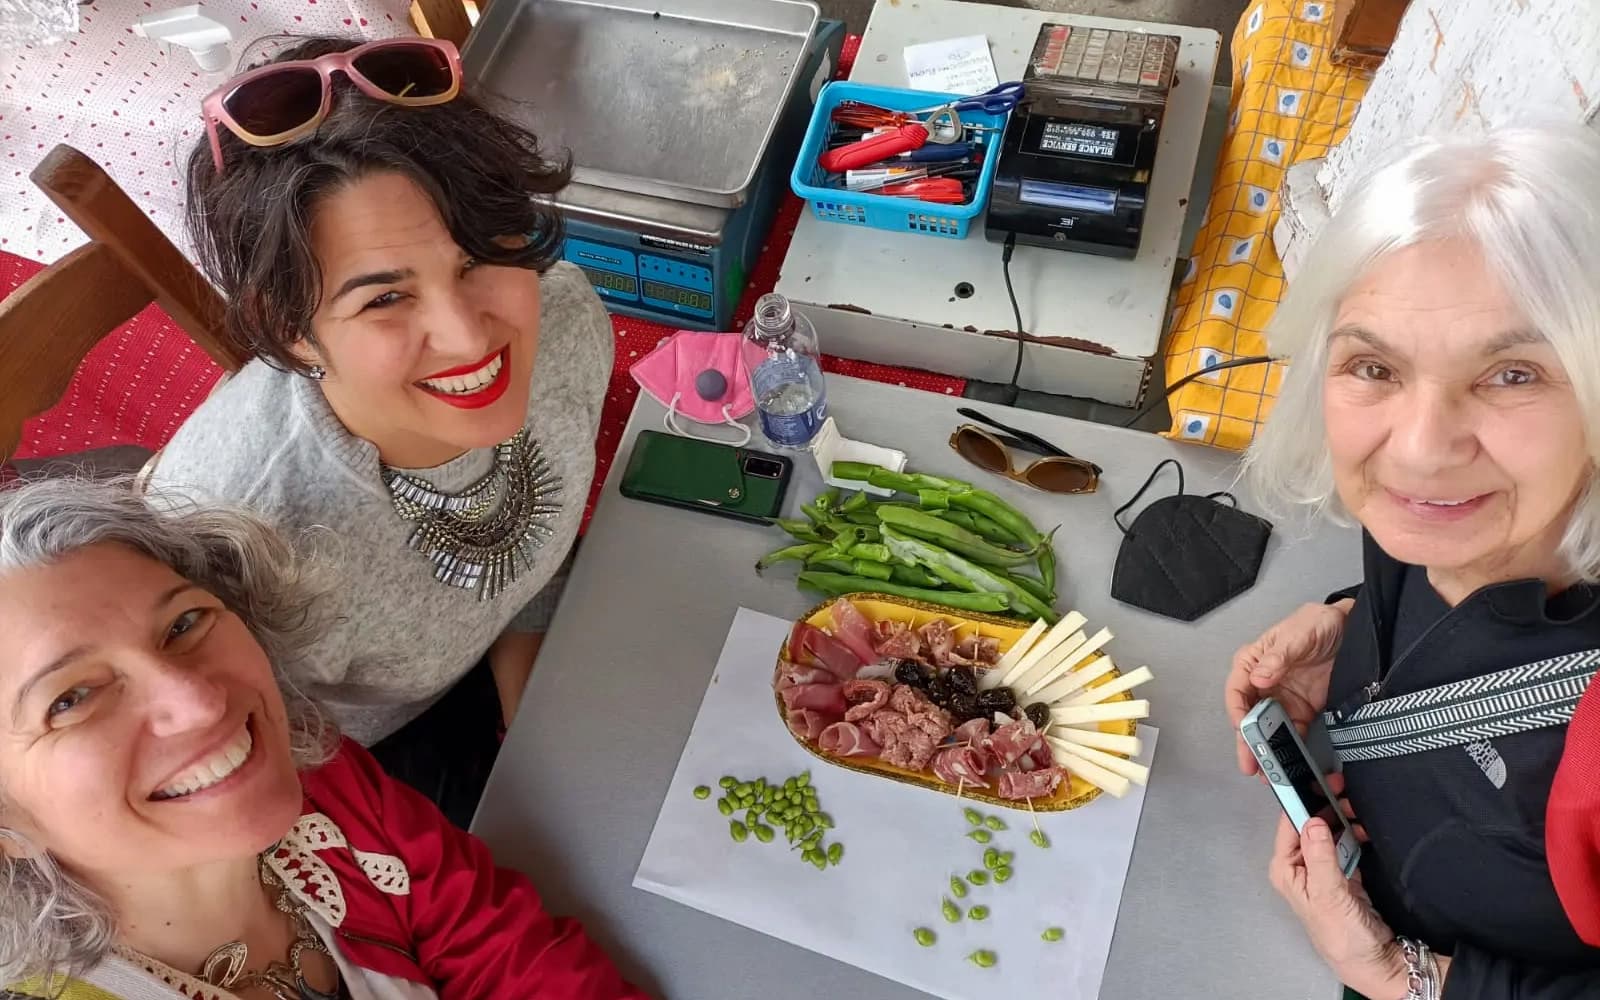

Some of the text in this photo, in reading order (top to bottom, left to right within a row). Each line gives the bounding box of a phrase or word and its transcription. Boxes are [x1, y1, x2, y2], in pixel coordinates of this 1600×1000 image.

[1042, 139, 1077, 152] SERVICE
[1078, 144, 1113, 156] BILANCE
[1464, 744, 1489, 771] FACE
